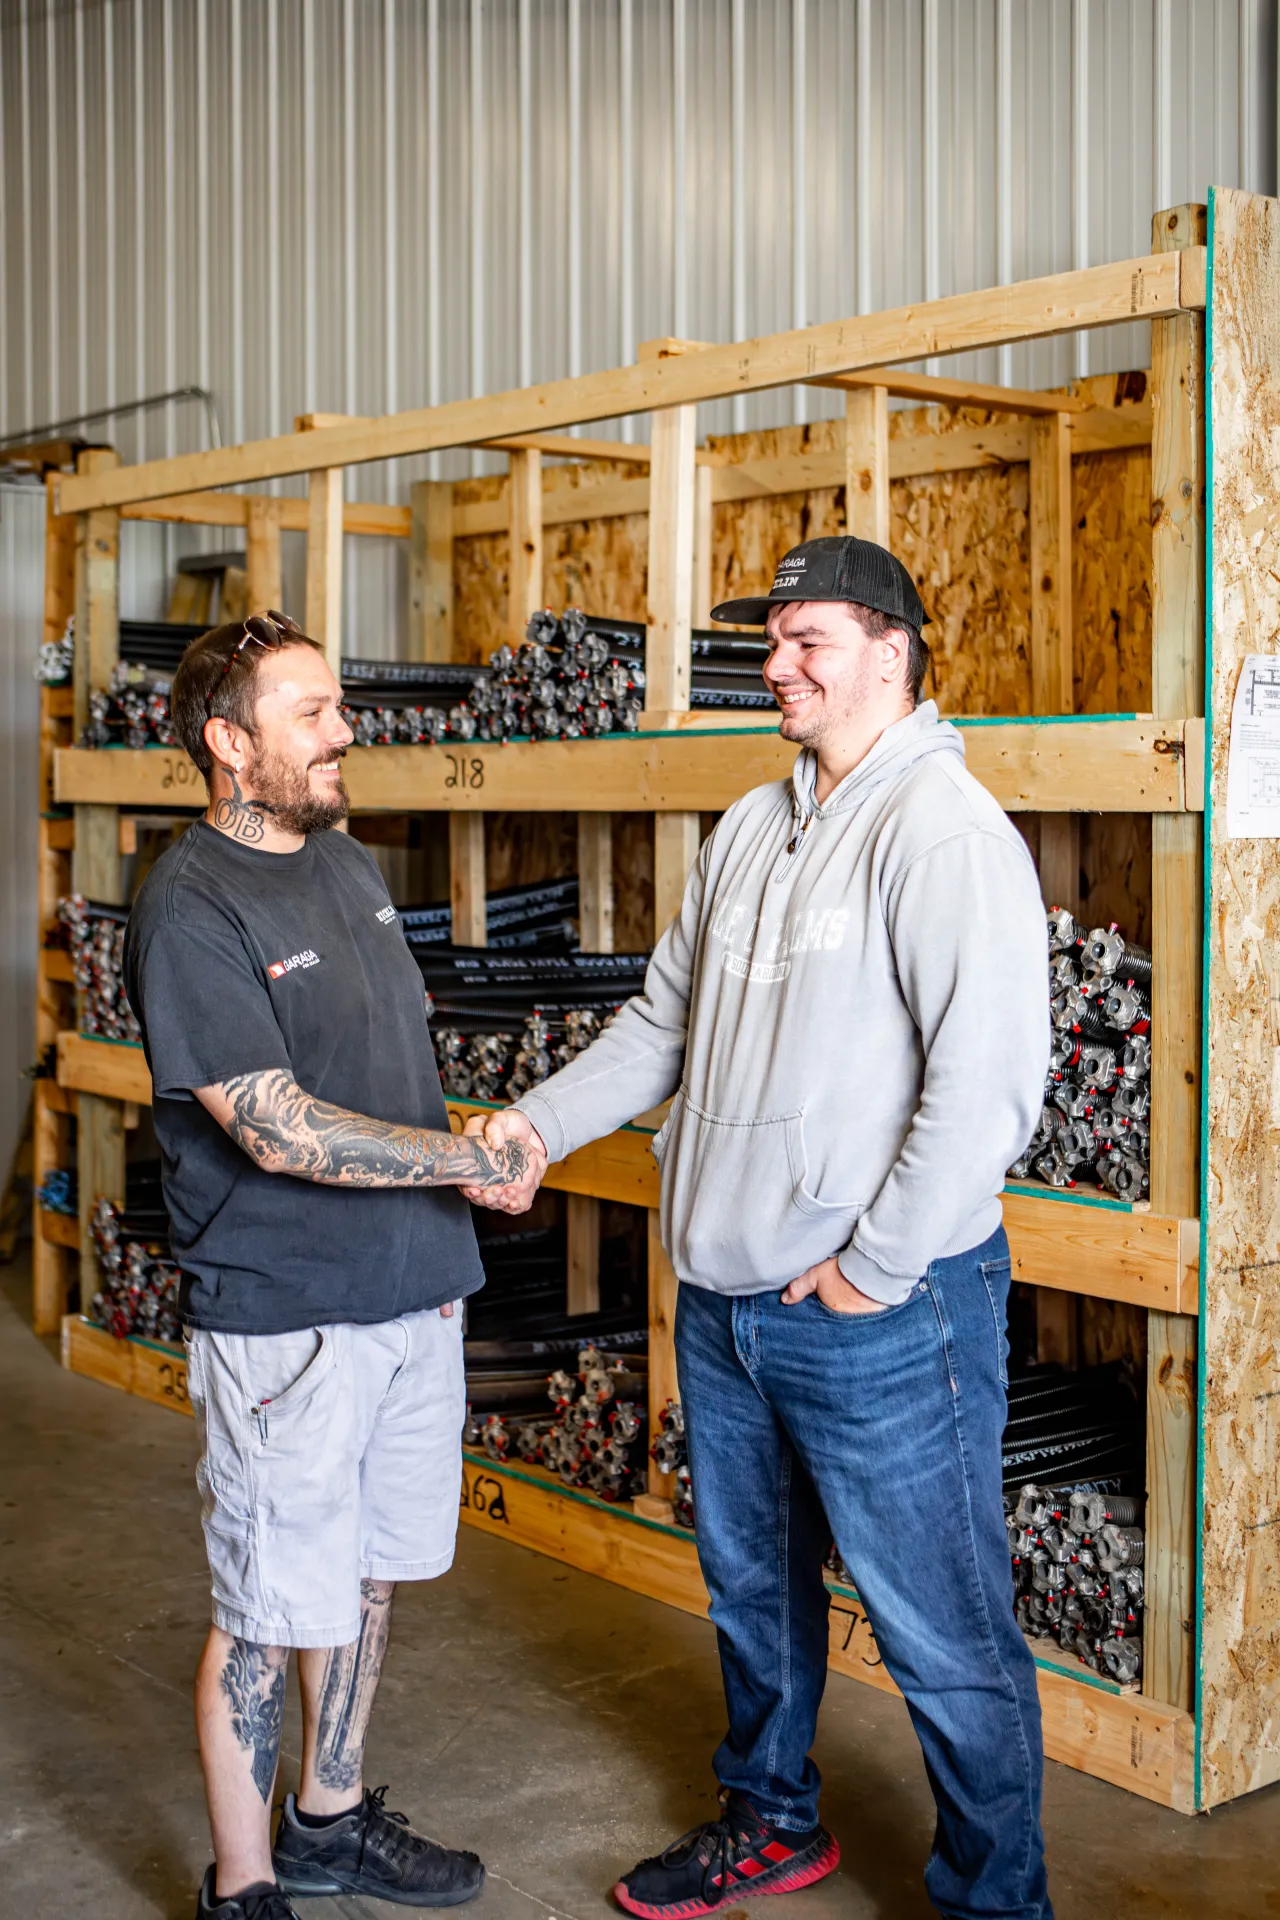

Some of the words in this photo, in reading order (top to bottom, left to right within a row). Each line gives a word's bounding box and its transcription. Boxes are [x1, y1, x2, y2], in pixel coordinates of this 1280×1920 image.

[778, 557, 806, 569] ARAGA
[444, 753, 485, 790] 218
[283, 949, 318, 972] GARAGA
[158, 1362, 188, 1402] 25
